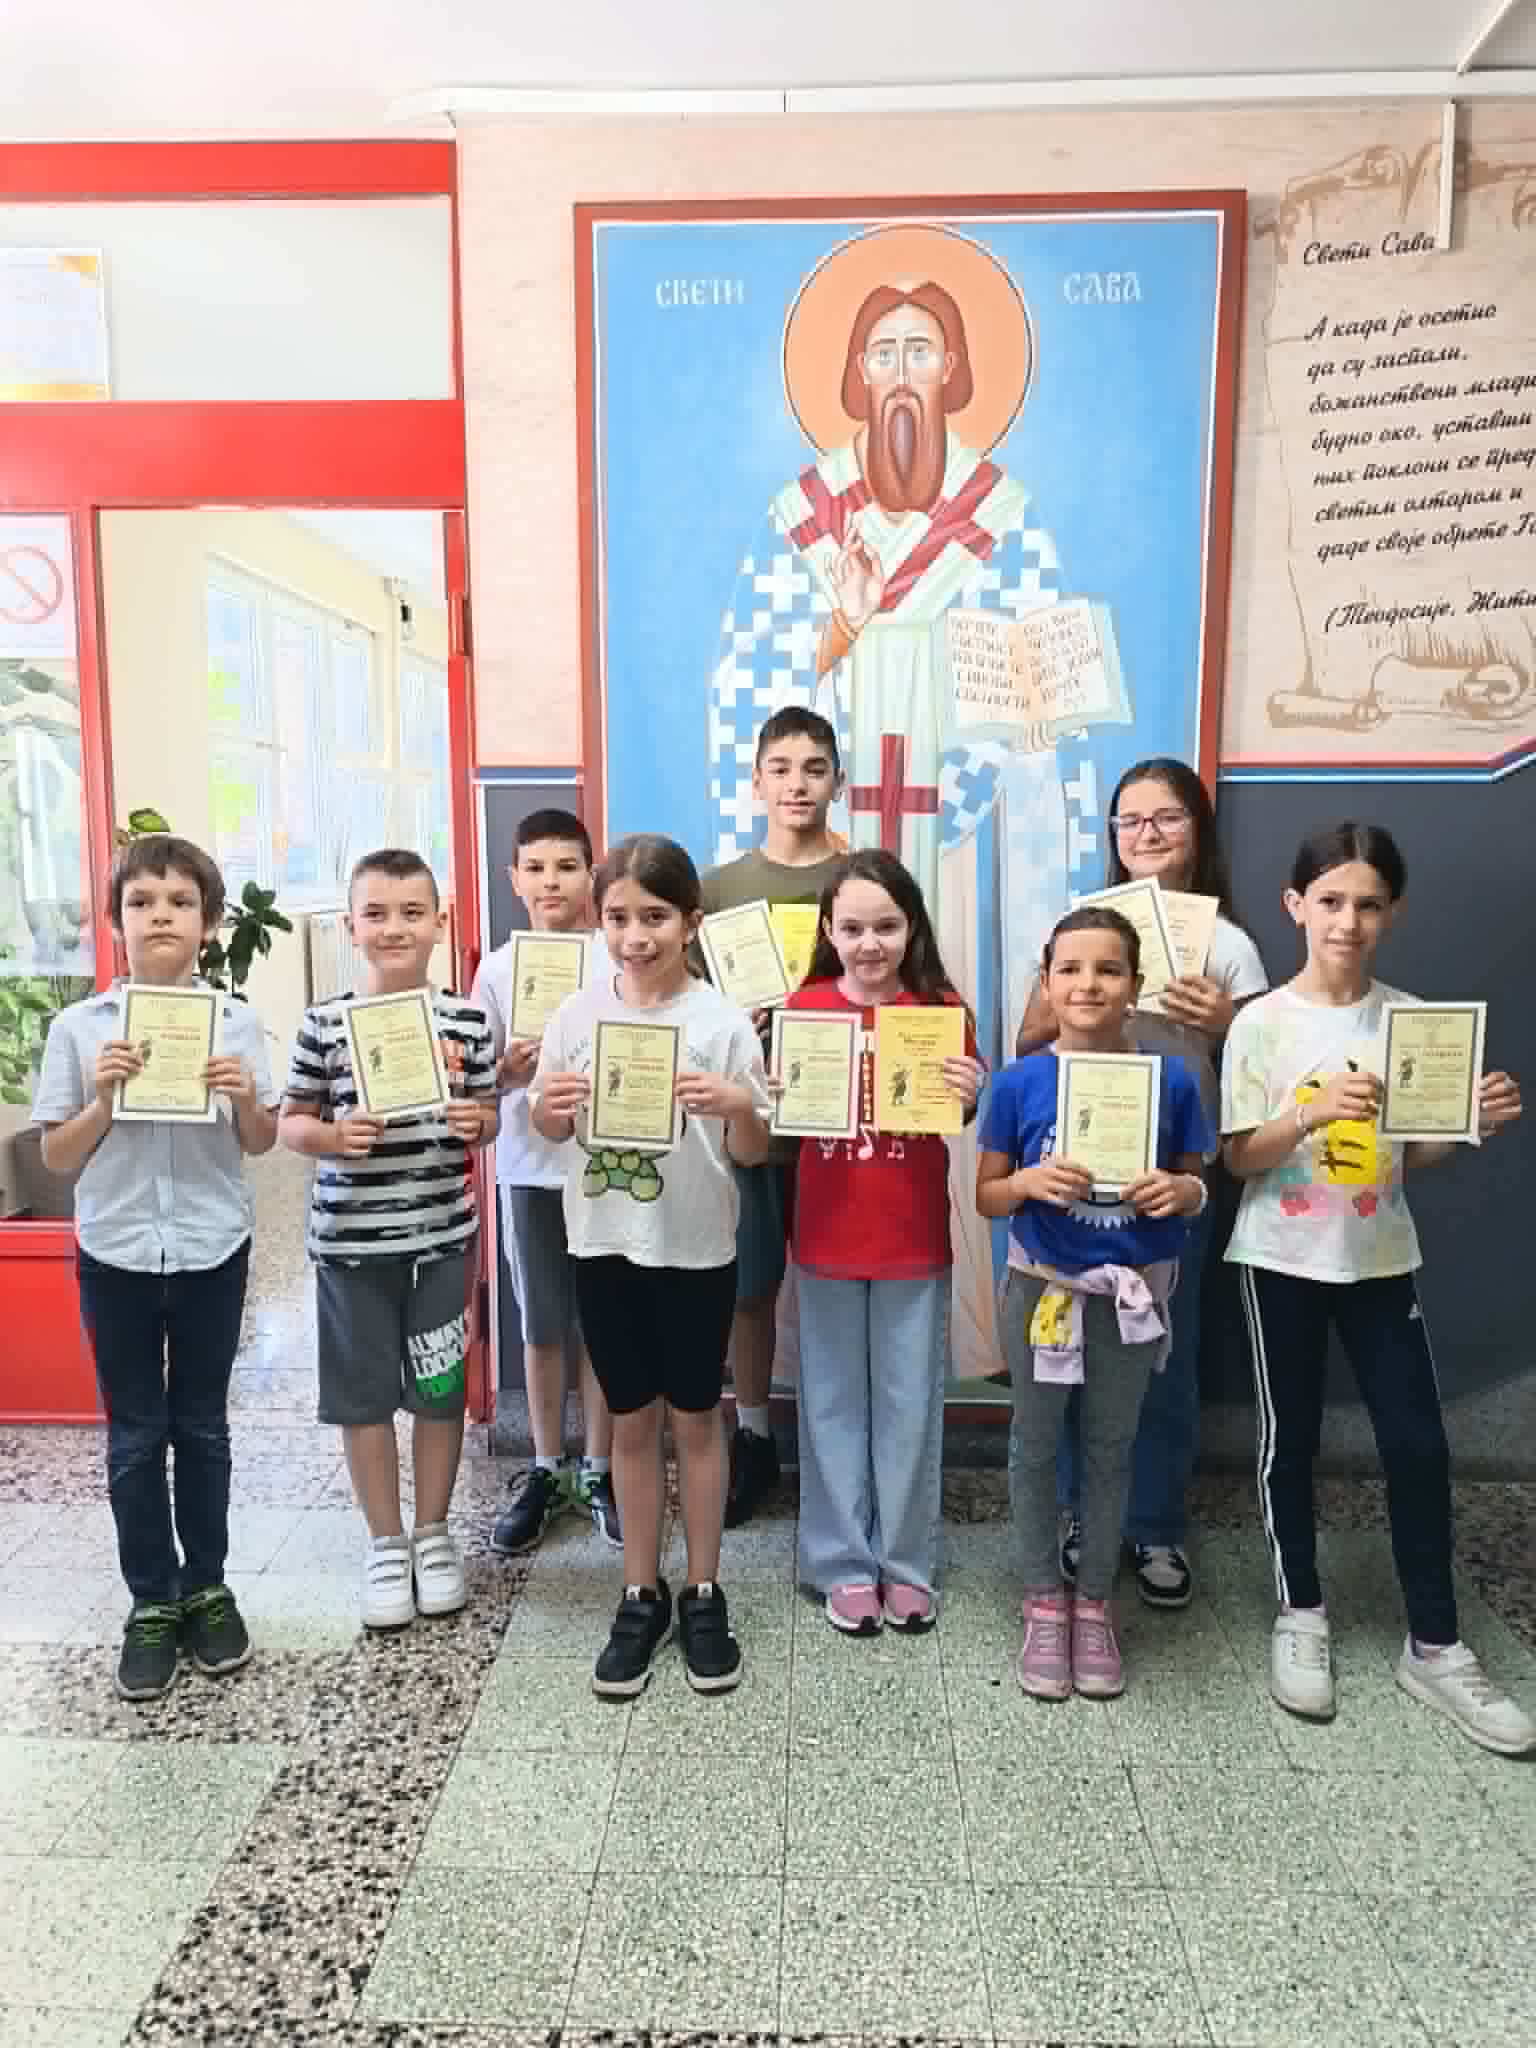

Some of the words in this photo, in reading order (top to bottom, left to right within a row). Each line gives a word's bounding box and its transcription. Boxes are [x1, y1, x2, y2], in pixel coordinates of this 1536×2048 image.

[1303, 241, 1371, 265] Свети
[1381, 231, 1435, 256] Сава
[1332, 317, 1388, 340] када
[1392, 306, 1414, 336] је
[1418, 303, 1497, 328] осетио
[1307, 359, 1336, 384] да
[1342, 358, 1366, 379] су
[1309, 381, 1458, 414] божанствени
[1311, 427, 1373, 453] будно
[1432, 408, 1532, 441] уставши
[1362, 457, 1450, 481] поклони
[1457, 455, 1481, 471] се
[1314, 500, 1396, 523] светим
[1403, 488, 1503, 513] олтаром
[1509, 487, 1523, 501] и
[1317, 536, 1370, 566] даде
[1375, 528, 1427, 555] своје
